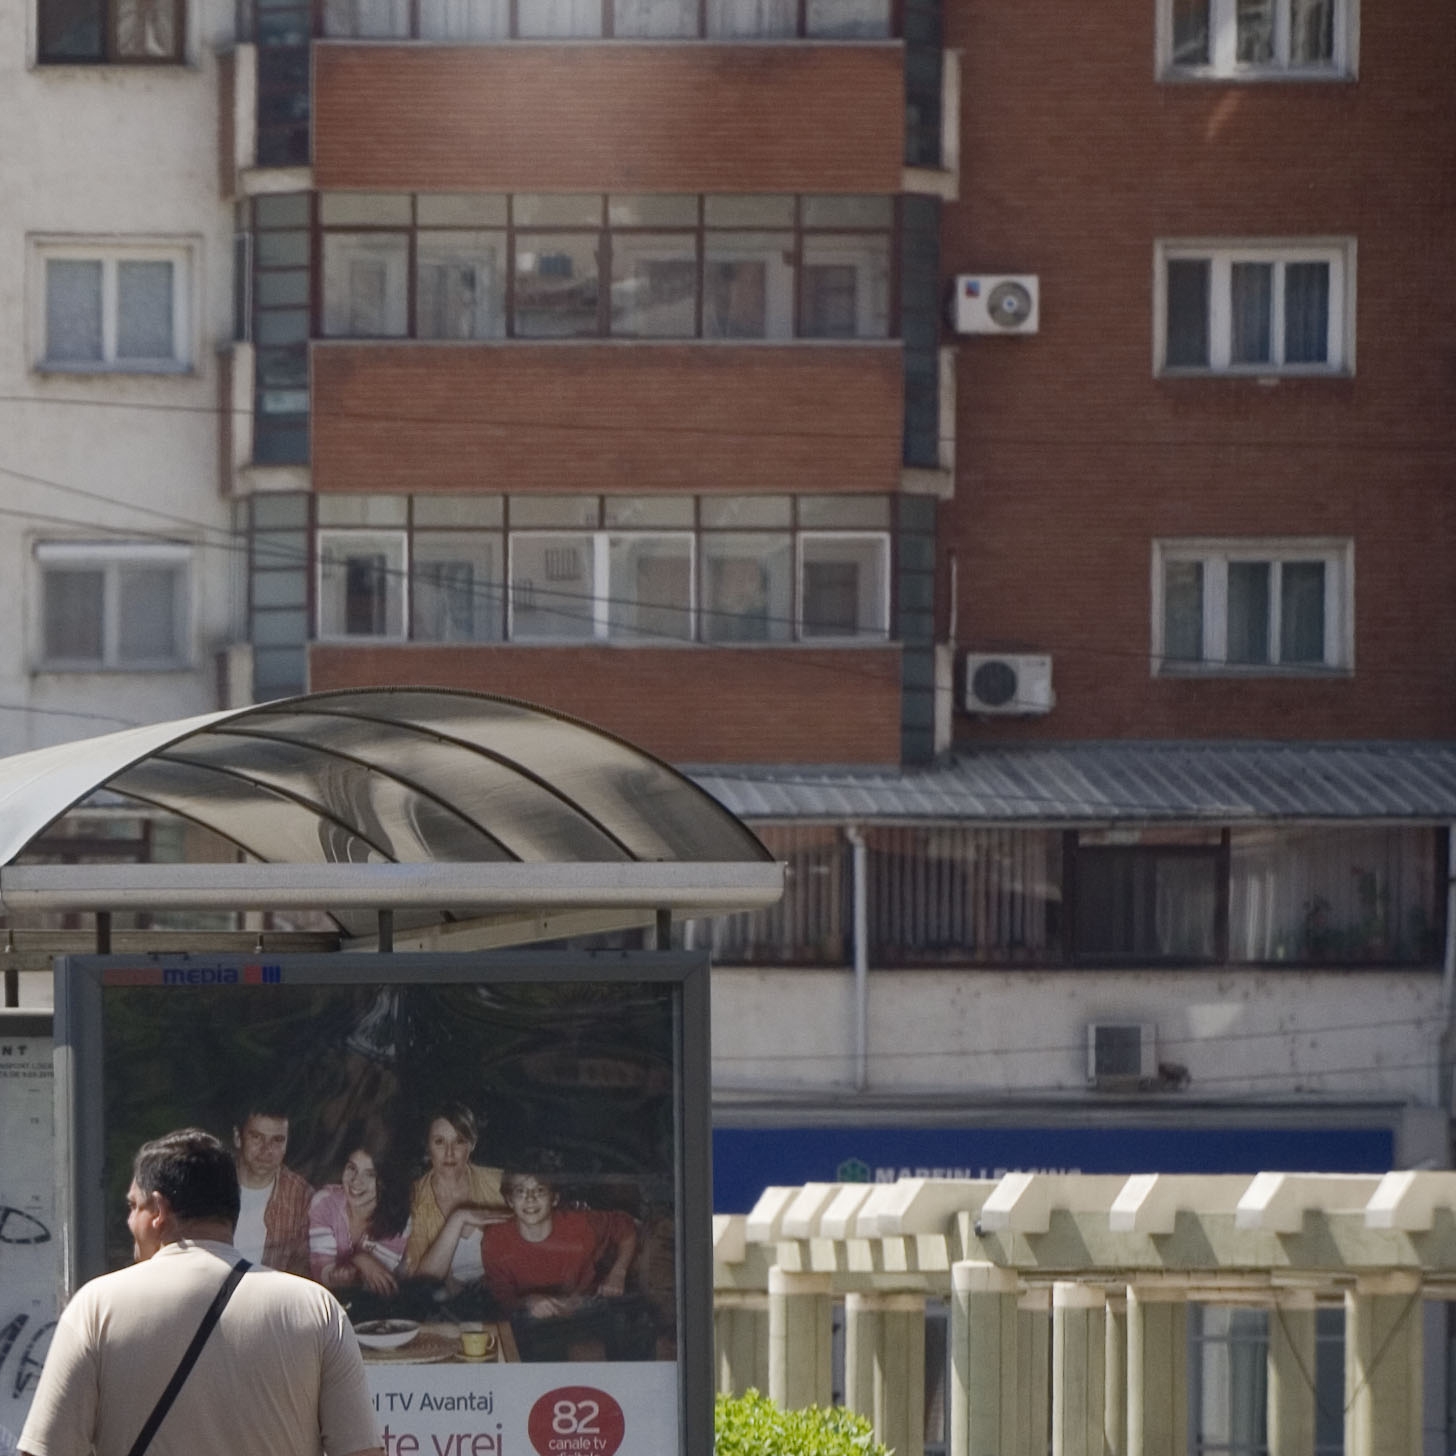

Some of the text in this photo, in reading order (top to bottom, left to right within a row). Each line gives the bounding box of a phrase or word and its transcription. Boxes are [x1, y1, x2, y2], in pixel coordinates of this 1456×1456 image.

[386, 1393, 412, 1411] TV
[419, 1392, 493, 1415] Avantaj
[552, 1400, 600, 1434] 82
[549, 1438, 607, 1451] canale tv
